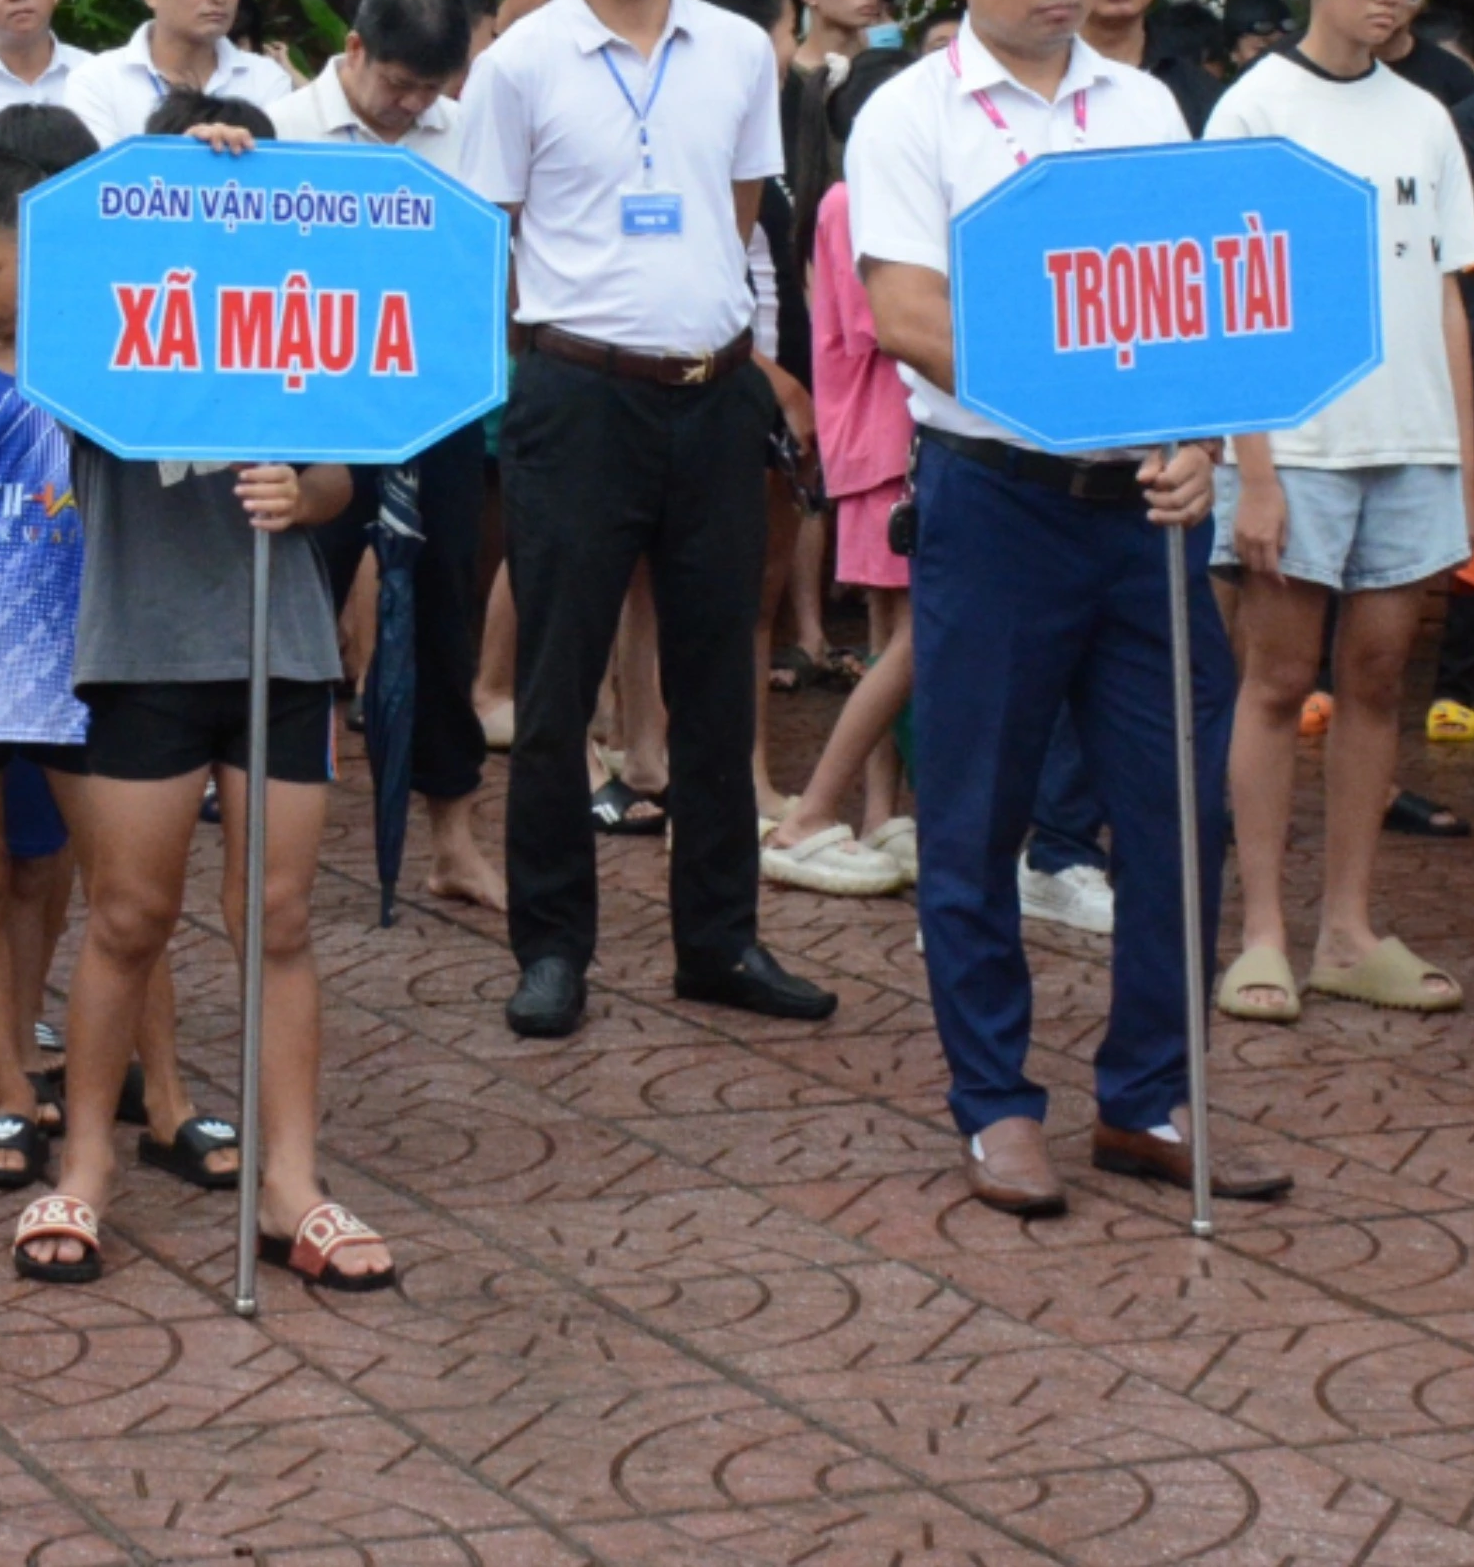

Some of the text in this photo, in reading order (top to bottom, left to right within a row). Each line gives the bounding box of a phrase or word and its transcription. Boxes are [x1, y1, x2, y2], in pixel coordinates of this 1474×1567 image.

[98, 176, 436, 236] ĐOÀN VẬN ĐỘNG VIÊN
[111, 268, 418, 392] XÃ MẬU A
[1045, 213, 1292, 369] TRỌNG TÀI
